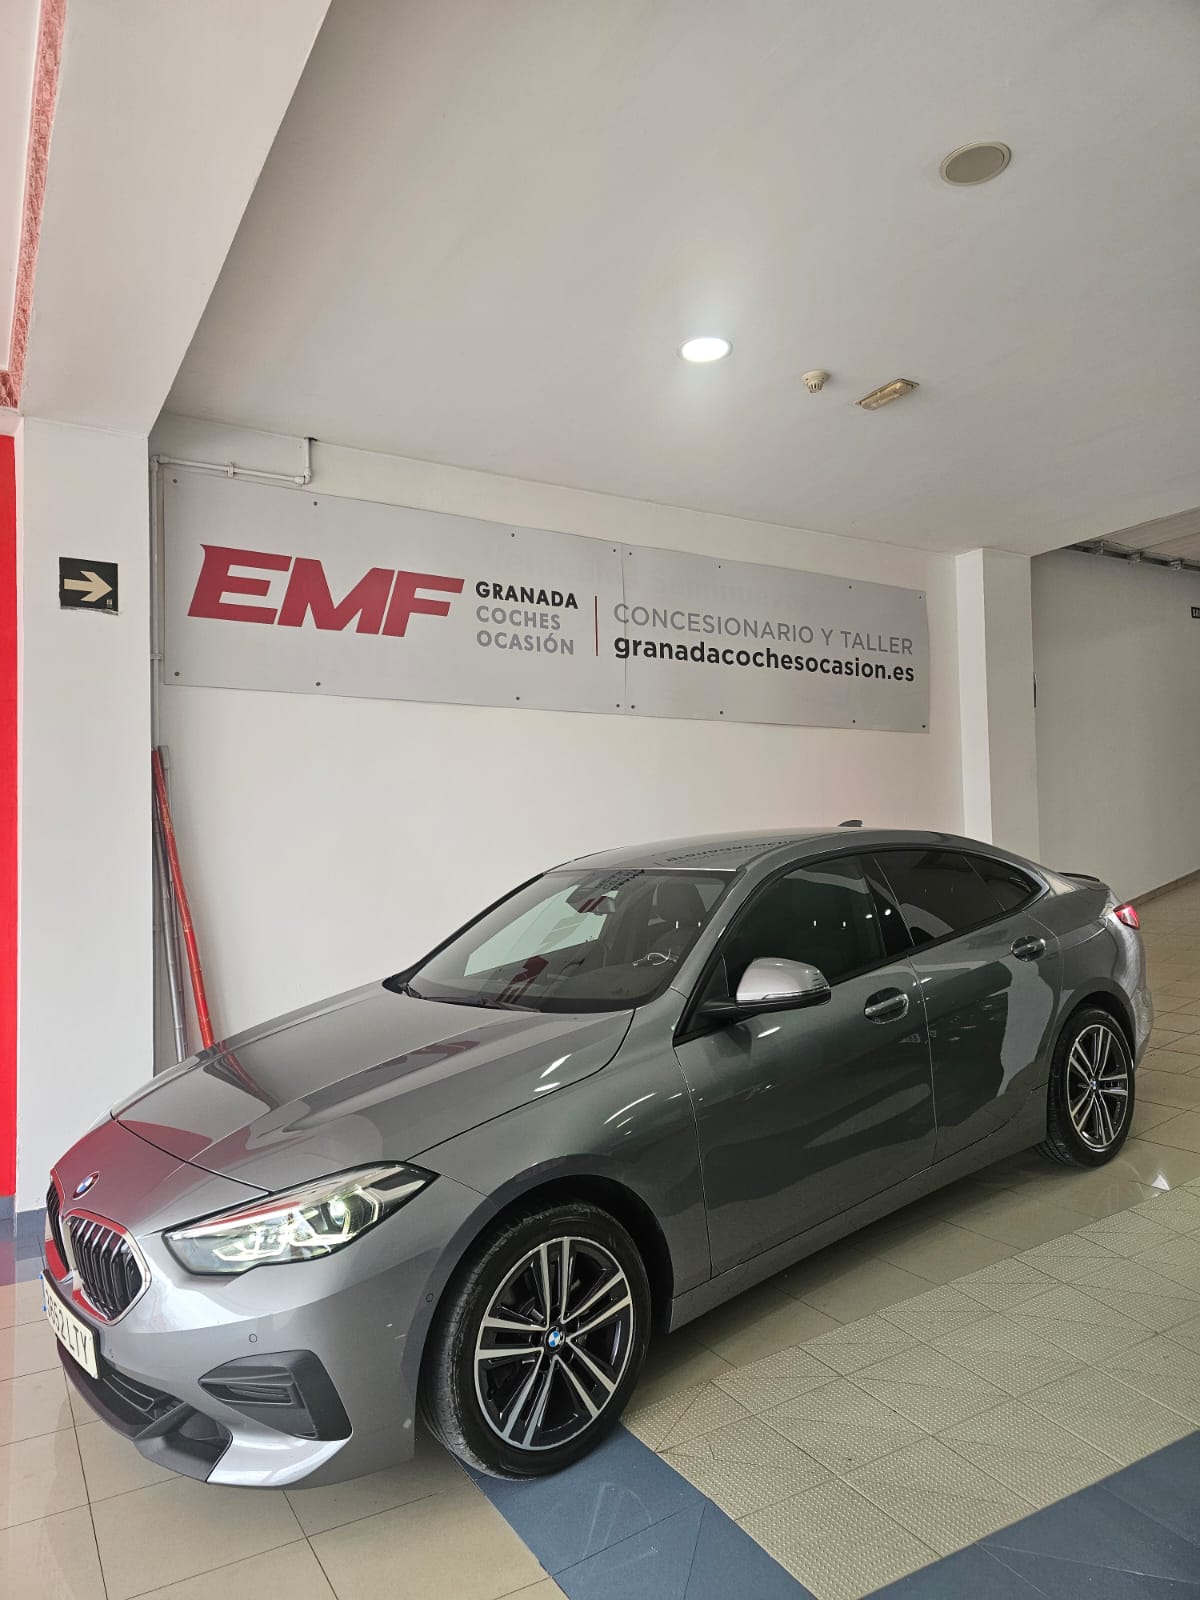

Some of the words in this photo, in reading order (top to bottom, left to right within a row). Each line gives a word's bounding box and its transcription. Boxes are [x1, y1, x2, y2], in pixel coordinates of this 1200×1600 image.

[187, 543, 465, 637] EMF
[475, 581, 579, 610] GRANADA
[476, 606, 562, 631] COCHES
[614, 603, 813, 644] CONCESIONARIO
[821, 628, 834, 647] Y
[840, 630, 913, 656] TALLER
[476, 630, 575, 656] OCASIÓN
[614, 635, 915, 682] granadacochesocasion.es
